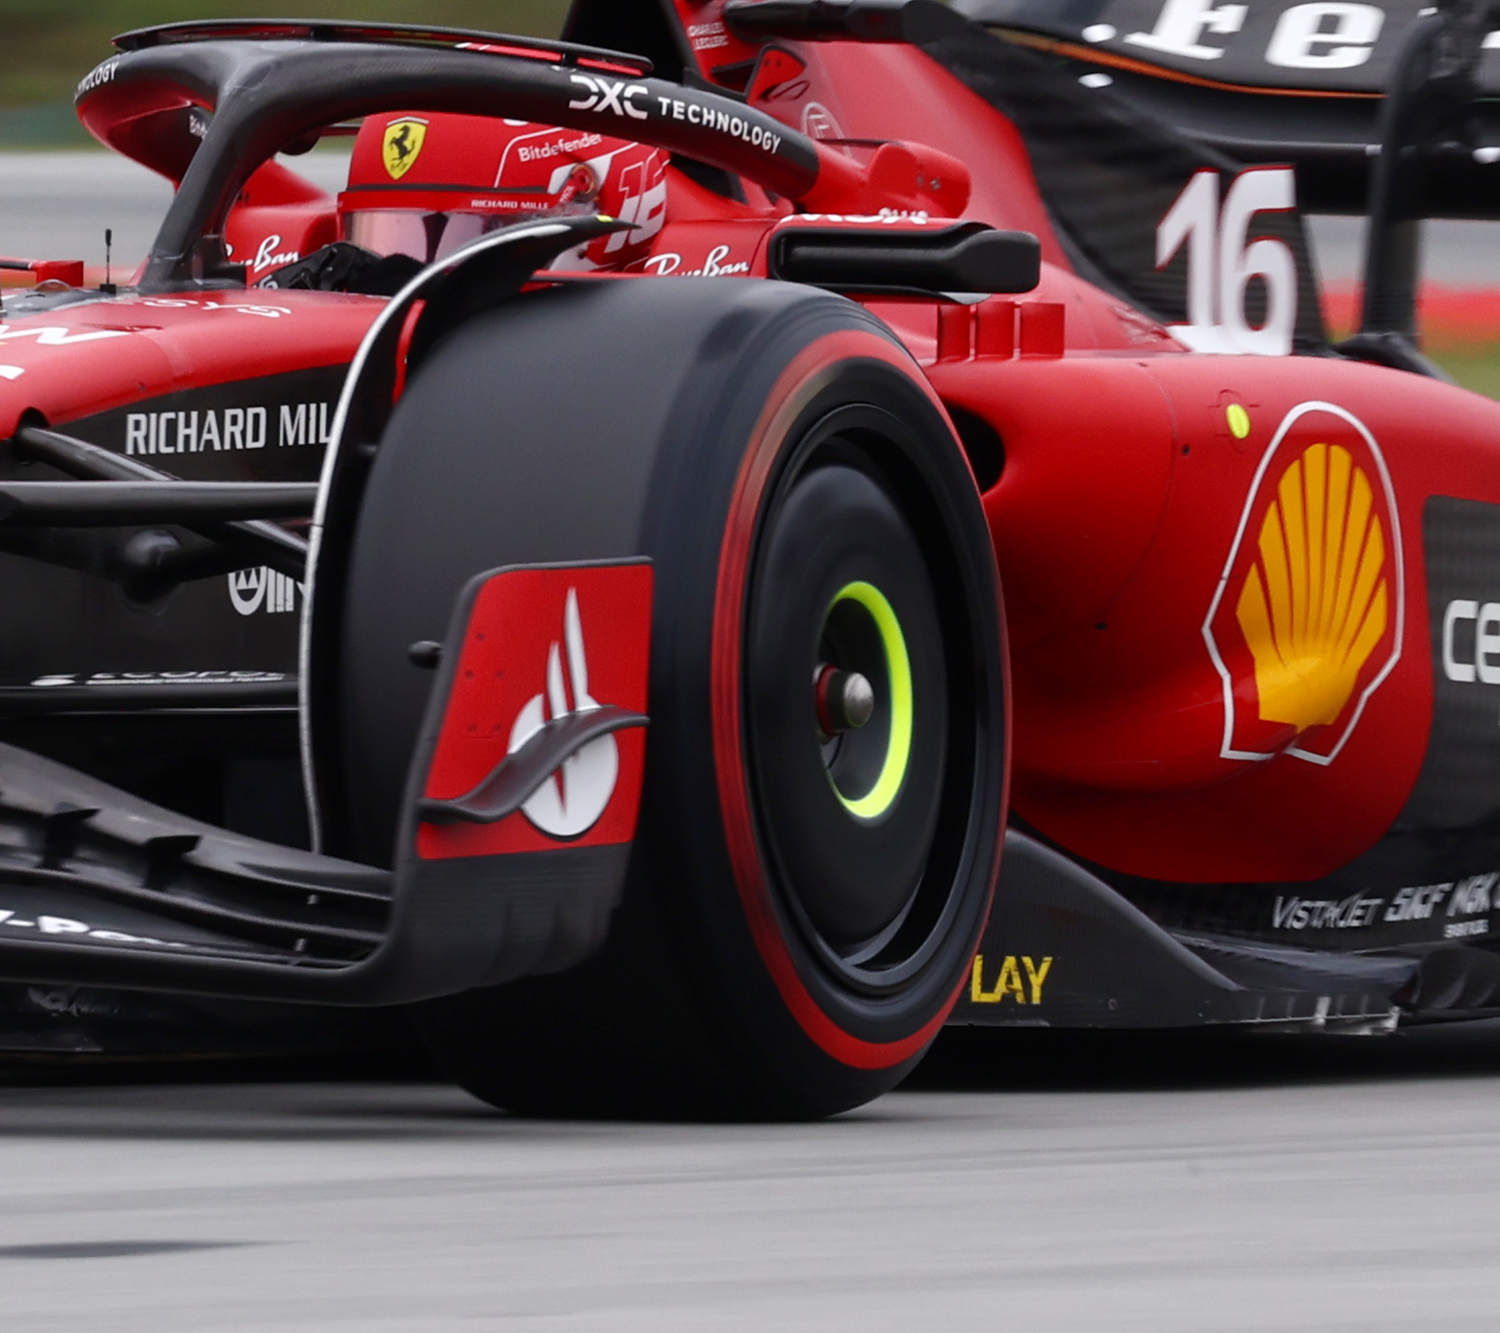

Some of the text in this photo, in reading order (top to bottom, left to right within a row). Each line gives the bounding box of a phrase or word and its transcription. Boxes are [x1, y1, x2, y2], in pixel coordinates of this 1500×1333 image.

[569, 75, 781, 155] DXC TECHNOLOGY
[517, 133, 603, 162] Bitdefender
[471, 199, 518, 209] RICHARD
[1154, 165, 1299, 356] 16
[126, 407, 267, 455] RICHARD
